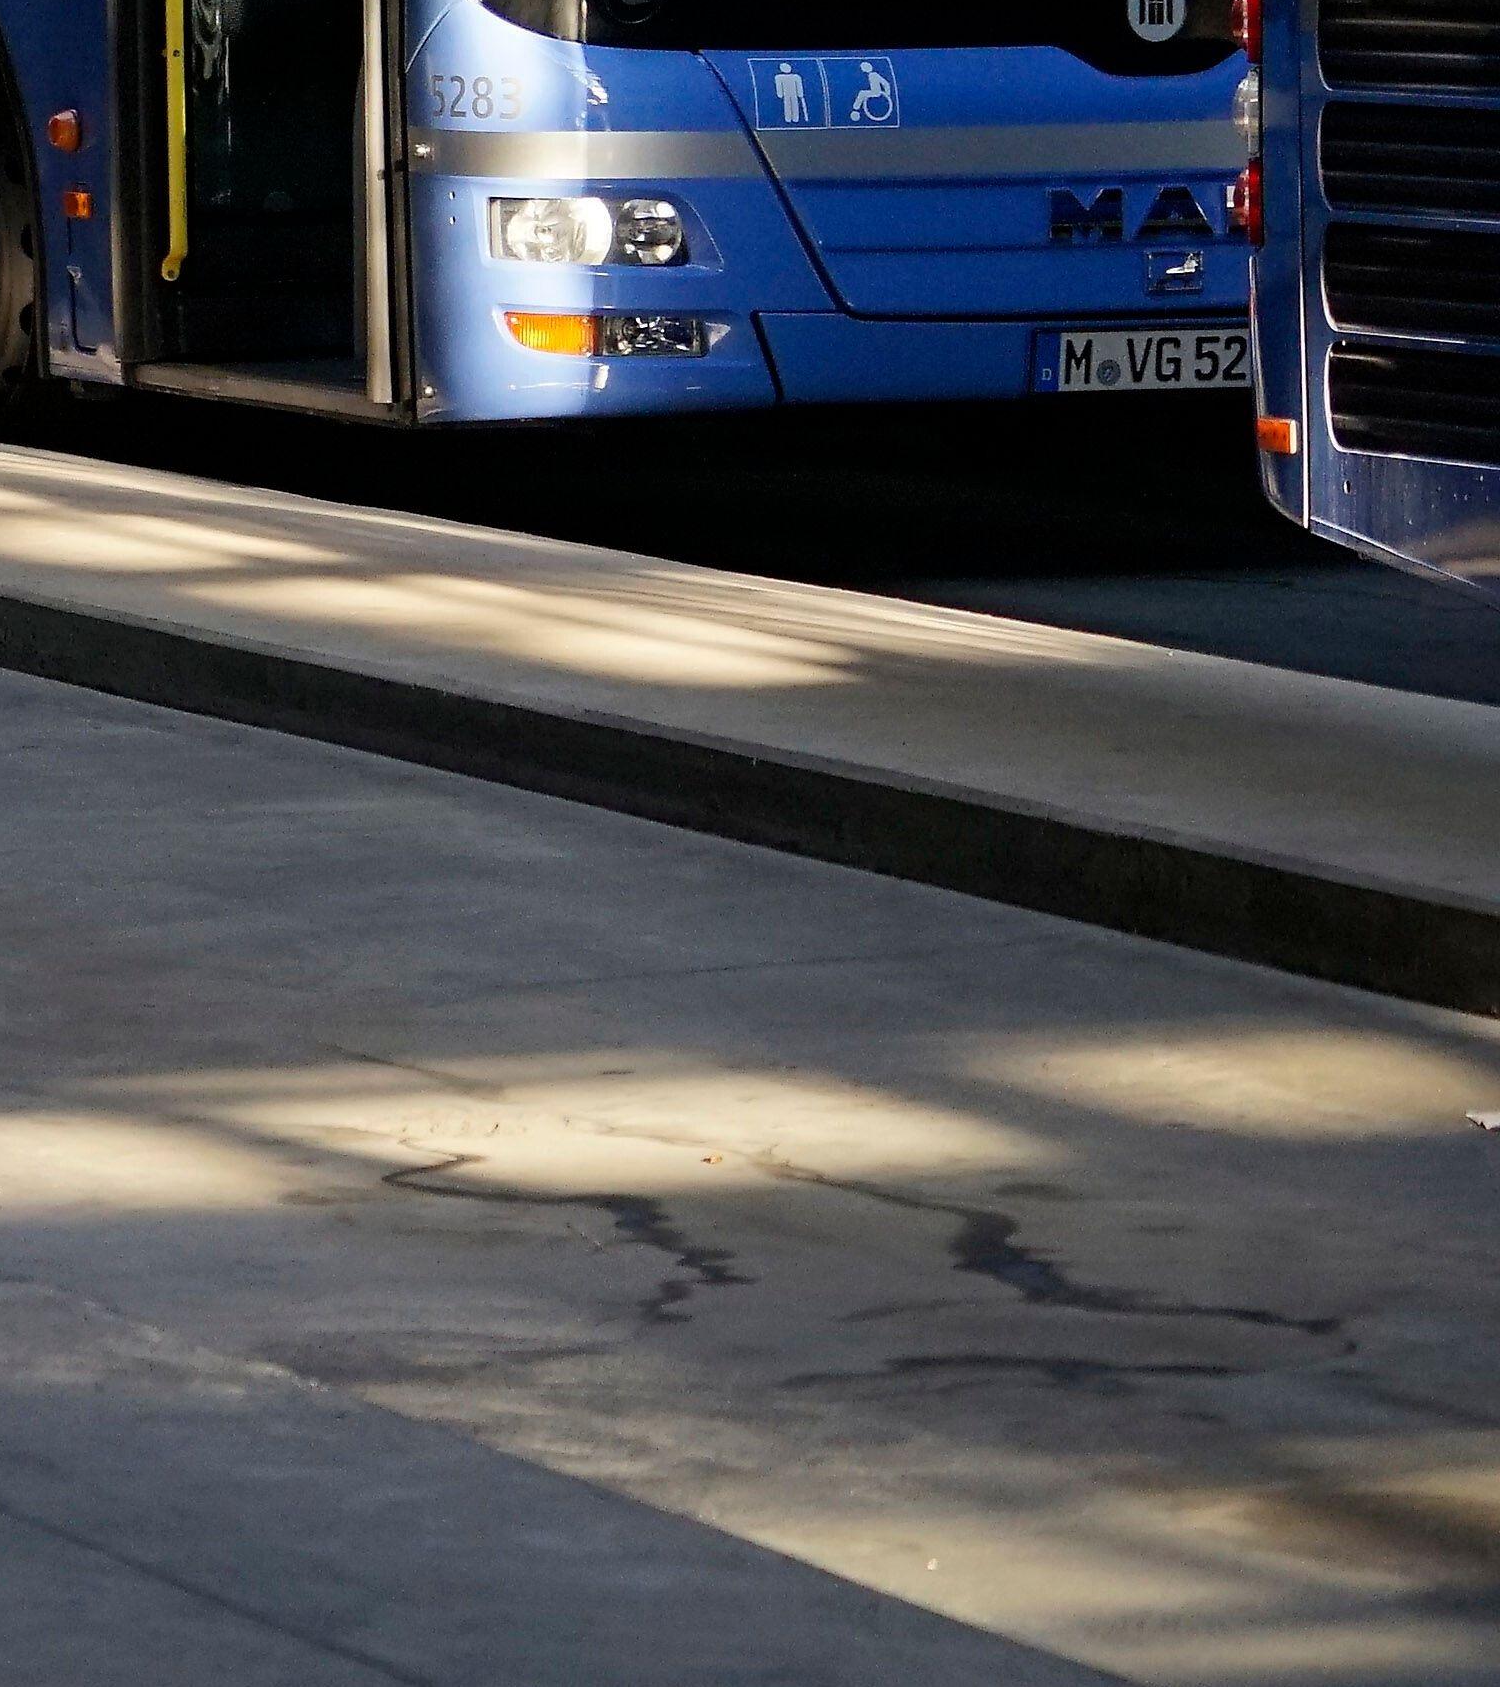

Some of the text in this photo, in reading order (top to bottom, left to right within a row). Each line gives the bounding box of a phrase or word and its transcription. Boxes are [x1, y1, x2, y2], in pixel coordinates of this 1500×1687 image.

[428, 73, 523, 120] 5283
[1065, 339, 1093, 385] M
[1127, 337, 1182, 382] VG
